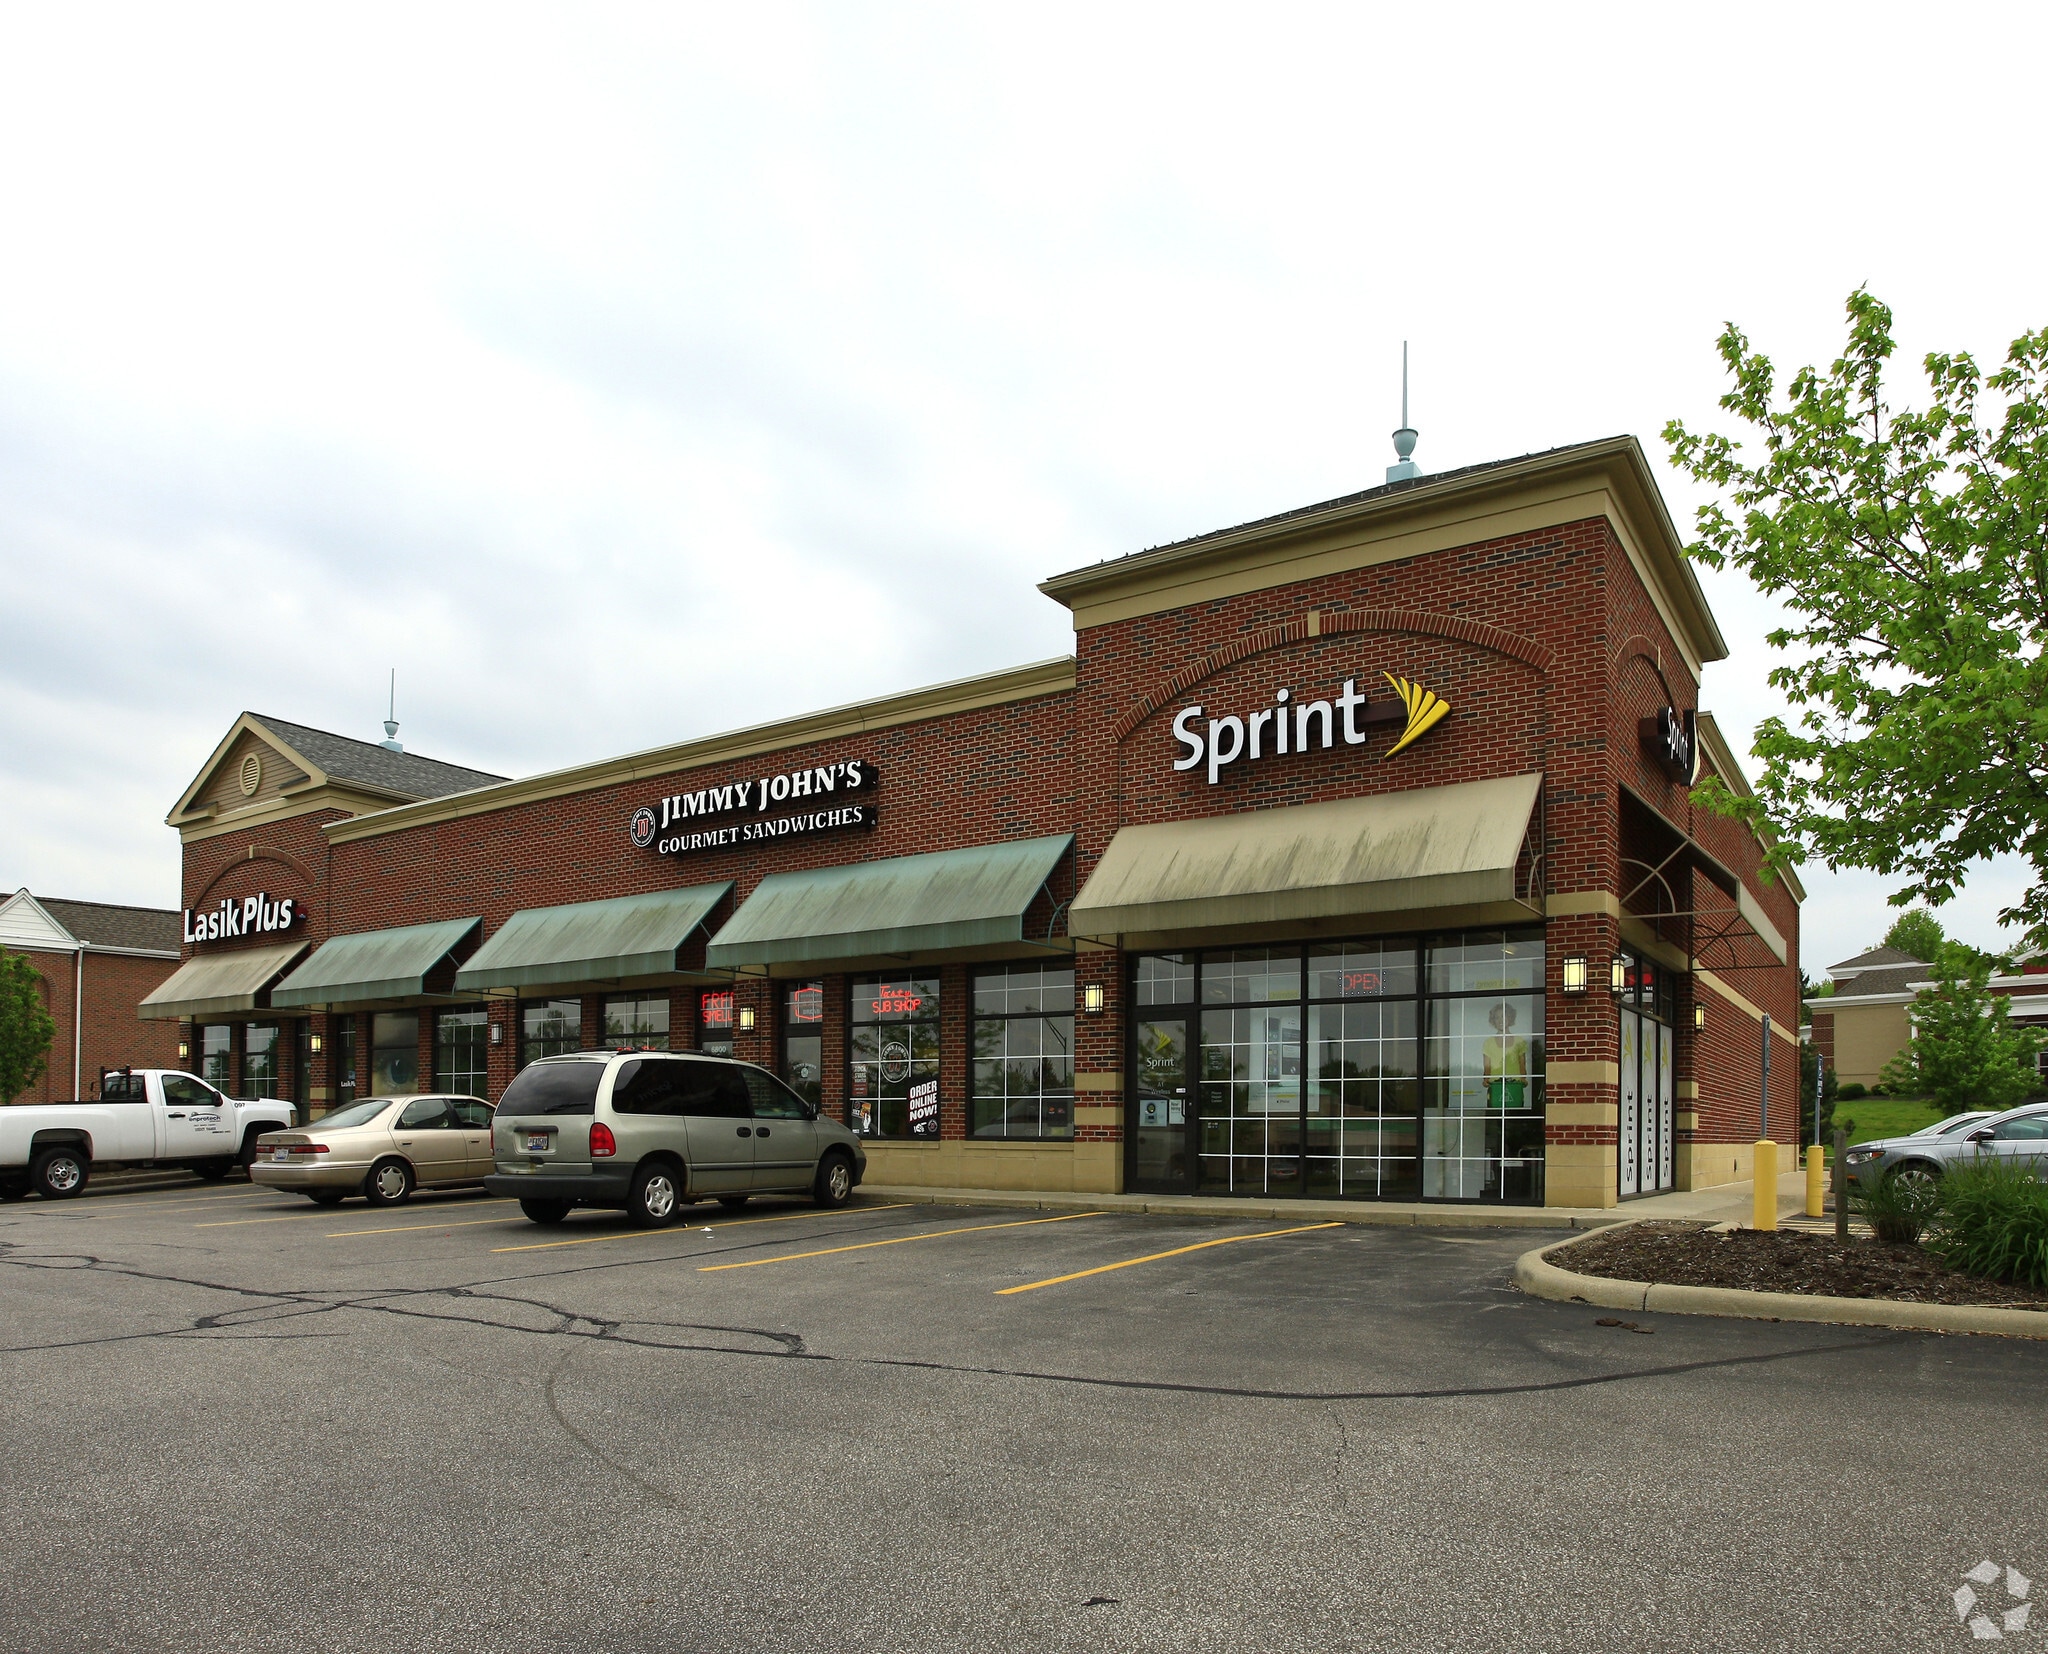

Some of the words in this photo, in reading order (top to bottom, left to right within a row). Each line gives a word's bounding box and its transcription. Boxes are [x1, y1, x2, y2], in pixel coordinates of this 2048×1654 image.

[1172, 678, 1366, 785] Sprint
[661, 781, 752, 830] JIMMY
[758, 760, 862, 812] JOHN'S
[658, 827, 740, 854] GOURMET
[743, 806, 864, 841] SANDWICHES
[872, 1000, 892, 1014] SUB
[894, 998, 921, 1013] SHOP
[711, 1045, 727, 1053] 6800
[1146, 1057, 1175, 1069] Sprint
[909, 1080, 938, 1099] ORDER
[909, 1092, 938, 1111] ONLINE
[909, 1104, 938, 1122] NOW!
[1626, 1091, 1634, 1182] Sprint
